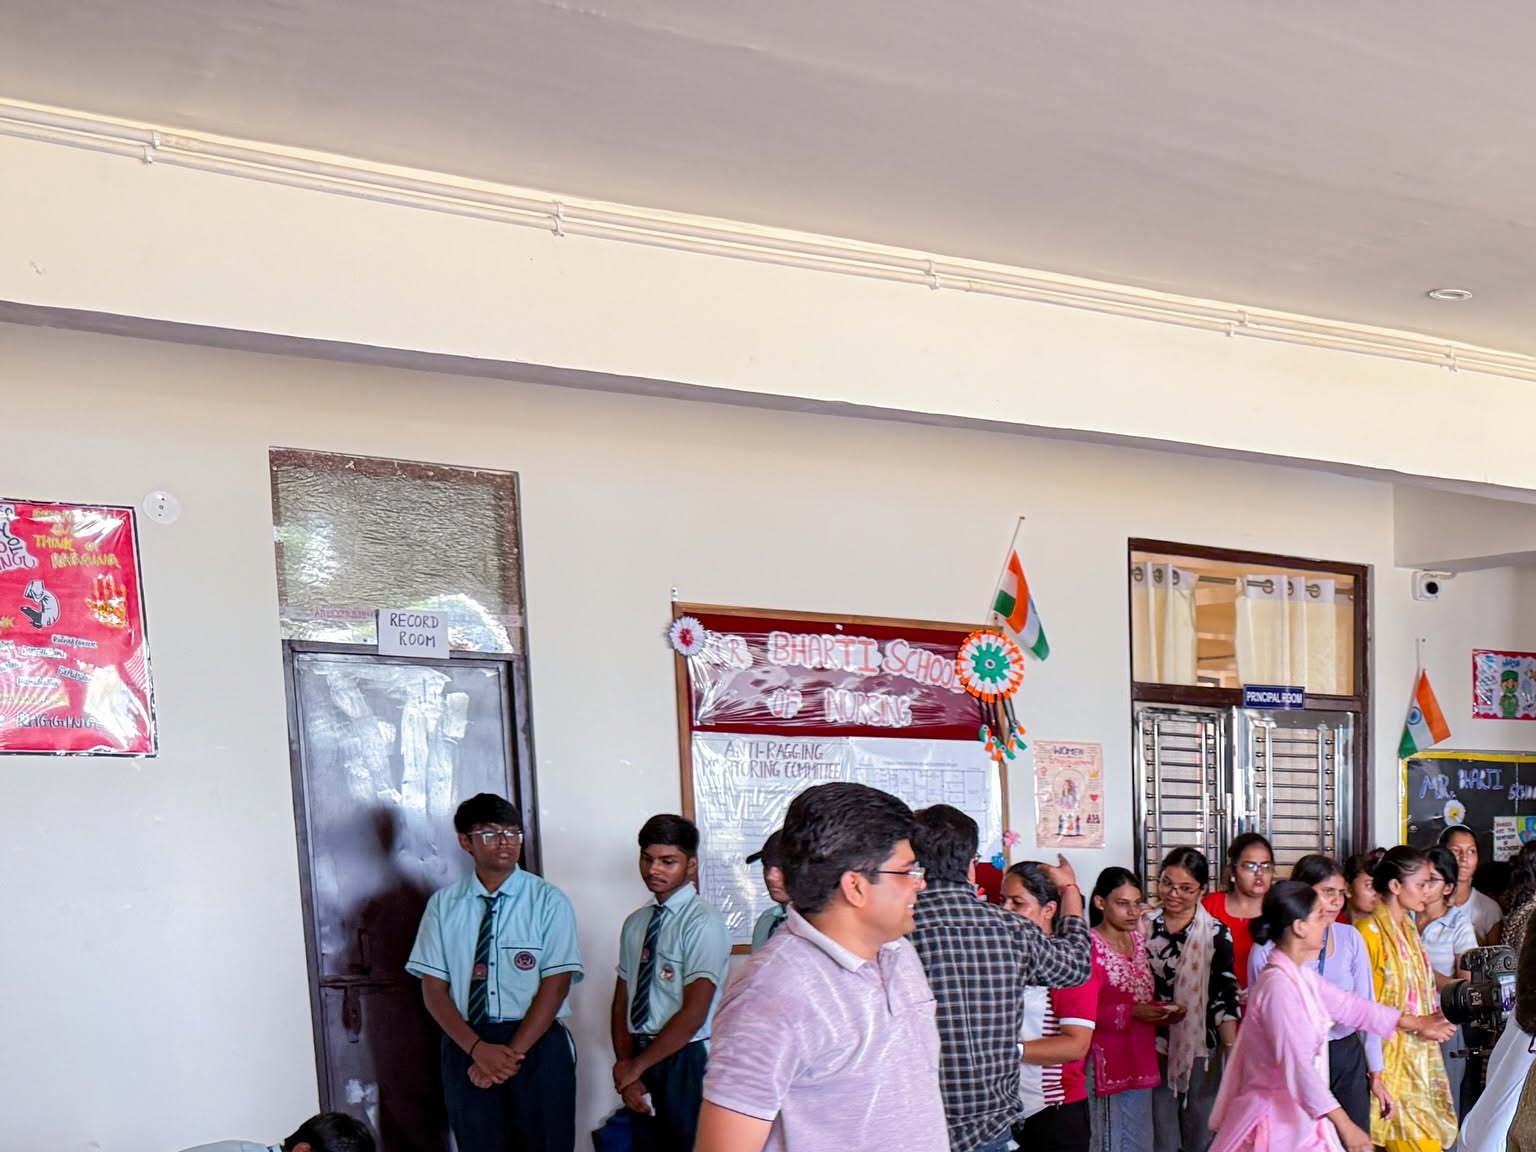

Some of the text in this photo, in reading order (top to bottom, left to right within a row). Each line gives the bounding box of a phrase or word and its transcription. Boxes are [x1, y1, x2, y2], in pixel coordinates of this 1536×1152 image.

[51, 552, 121, 569] RAGGING
[390, 612, 439, 629] RECORD
[399, 631, 436, 648] ROOM
[773, 633, 880, 673] BHARTI
[885, 639, 968, 692] SCHOOL
[1246, 691, 1303, 704] PRINCIPAL ROOM
[772, 688, 912, 725] OF NURSING
[18, 714, 98, 730] RAGGING
[724, 741, 824, 760] ANTI-RAGGING
